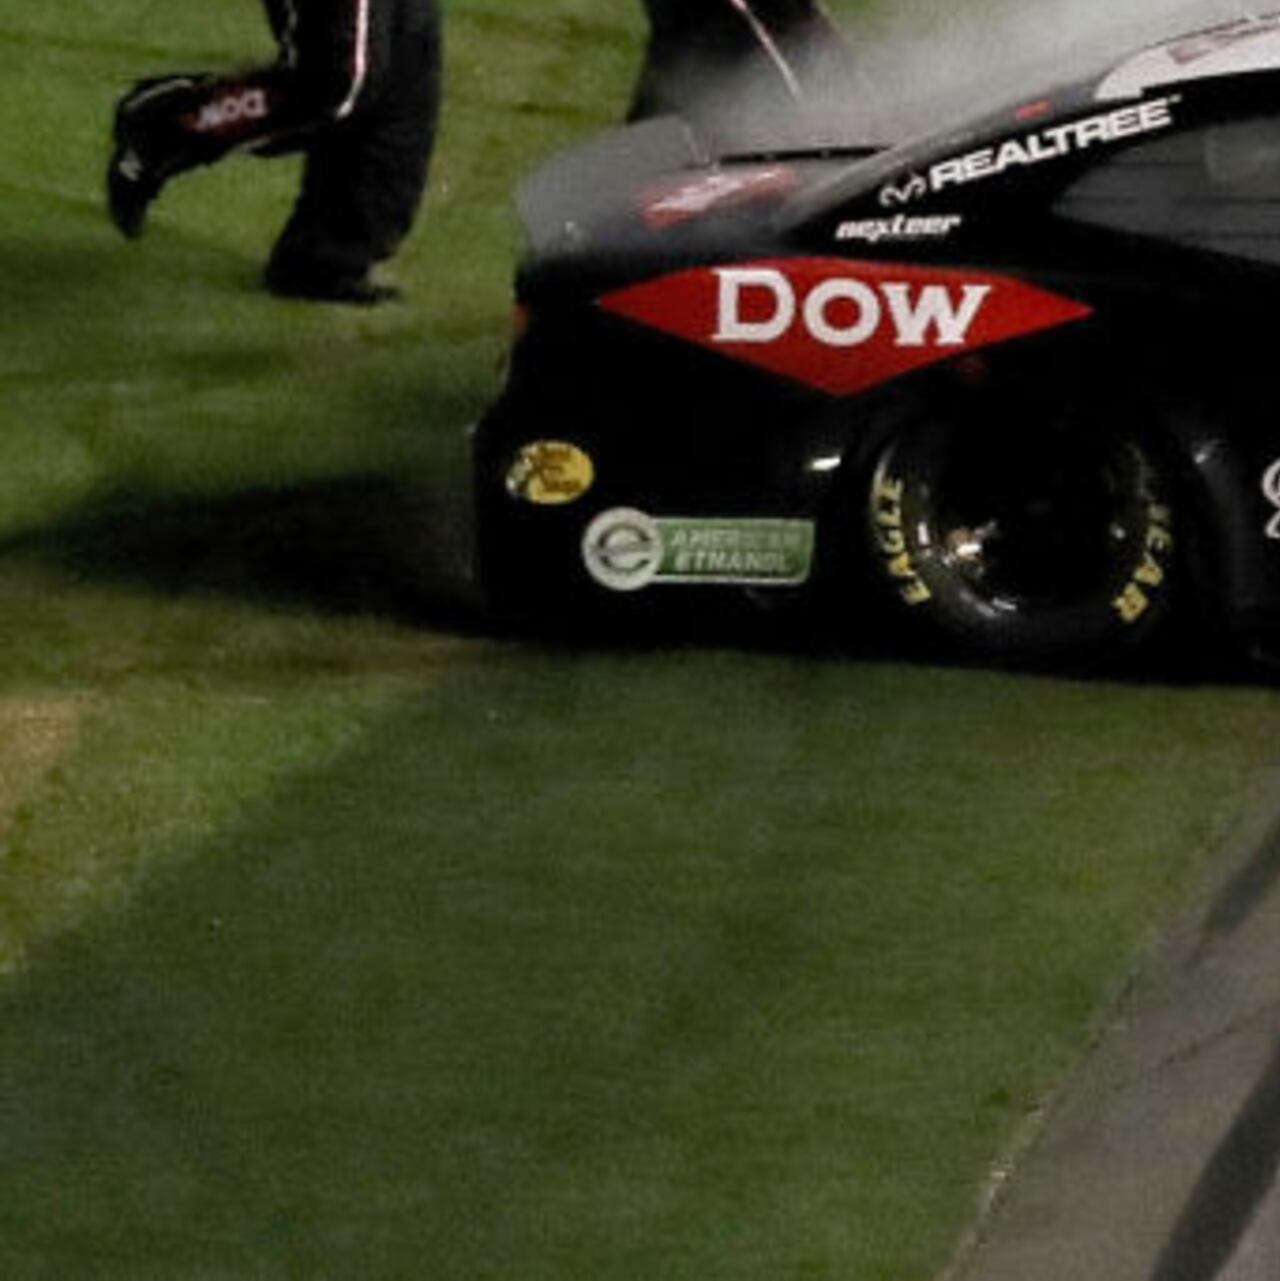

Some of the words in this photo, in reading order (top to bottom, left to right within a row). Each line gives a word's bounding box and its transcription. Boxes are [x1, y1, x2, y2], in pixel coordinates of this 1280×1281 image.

[929, 98, 1173, 190] REALTREE
[835, 213, 961, 242] nexteer
[710, 267, 992, 347] DOW
